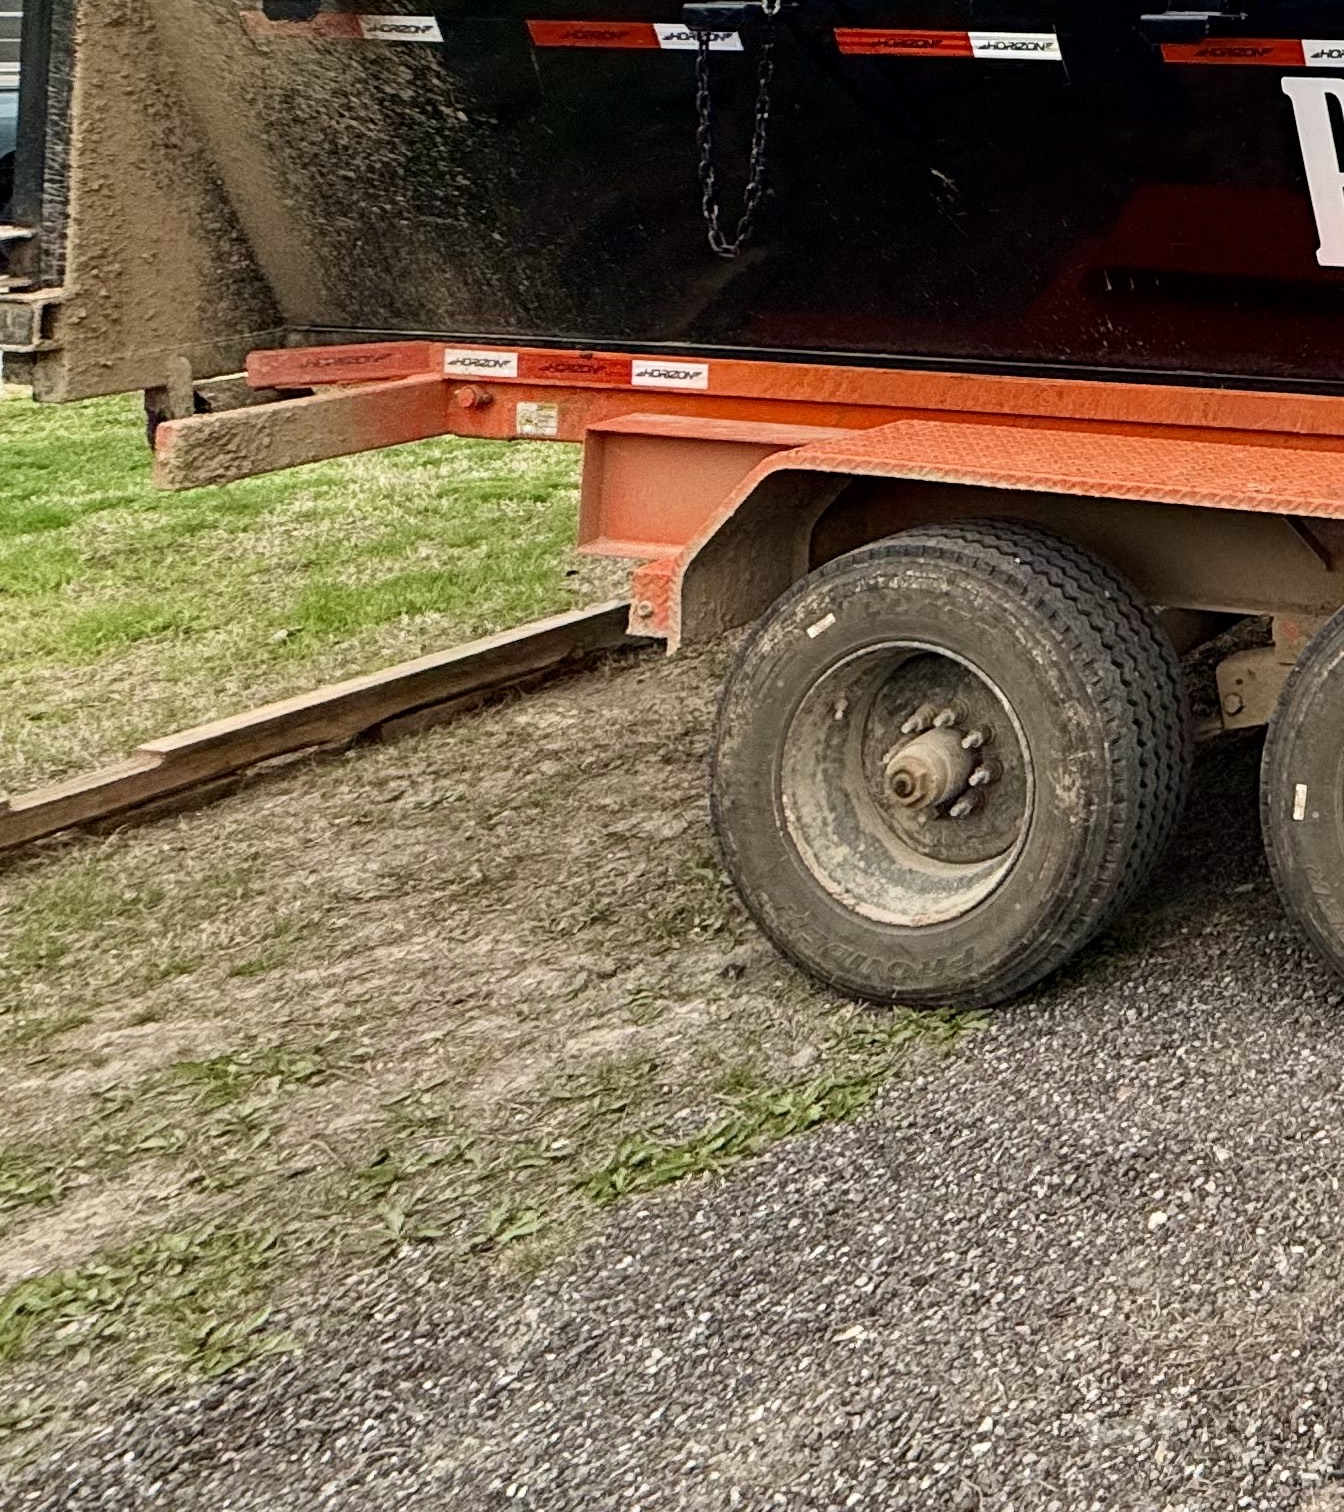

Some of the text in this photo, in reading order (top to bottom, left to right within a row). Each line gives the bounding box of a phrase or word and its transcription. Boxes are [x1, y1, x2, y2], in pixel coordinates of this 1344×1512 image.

[986, 40, 1047, 52] HORIZON
[455, 356, 506, 369] HORIZON
[643, 368, 696, 381] HORIZON
